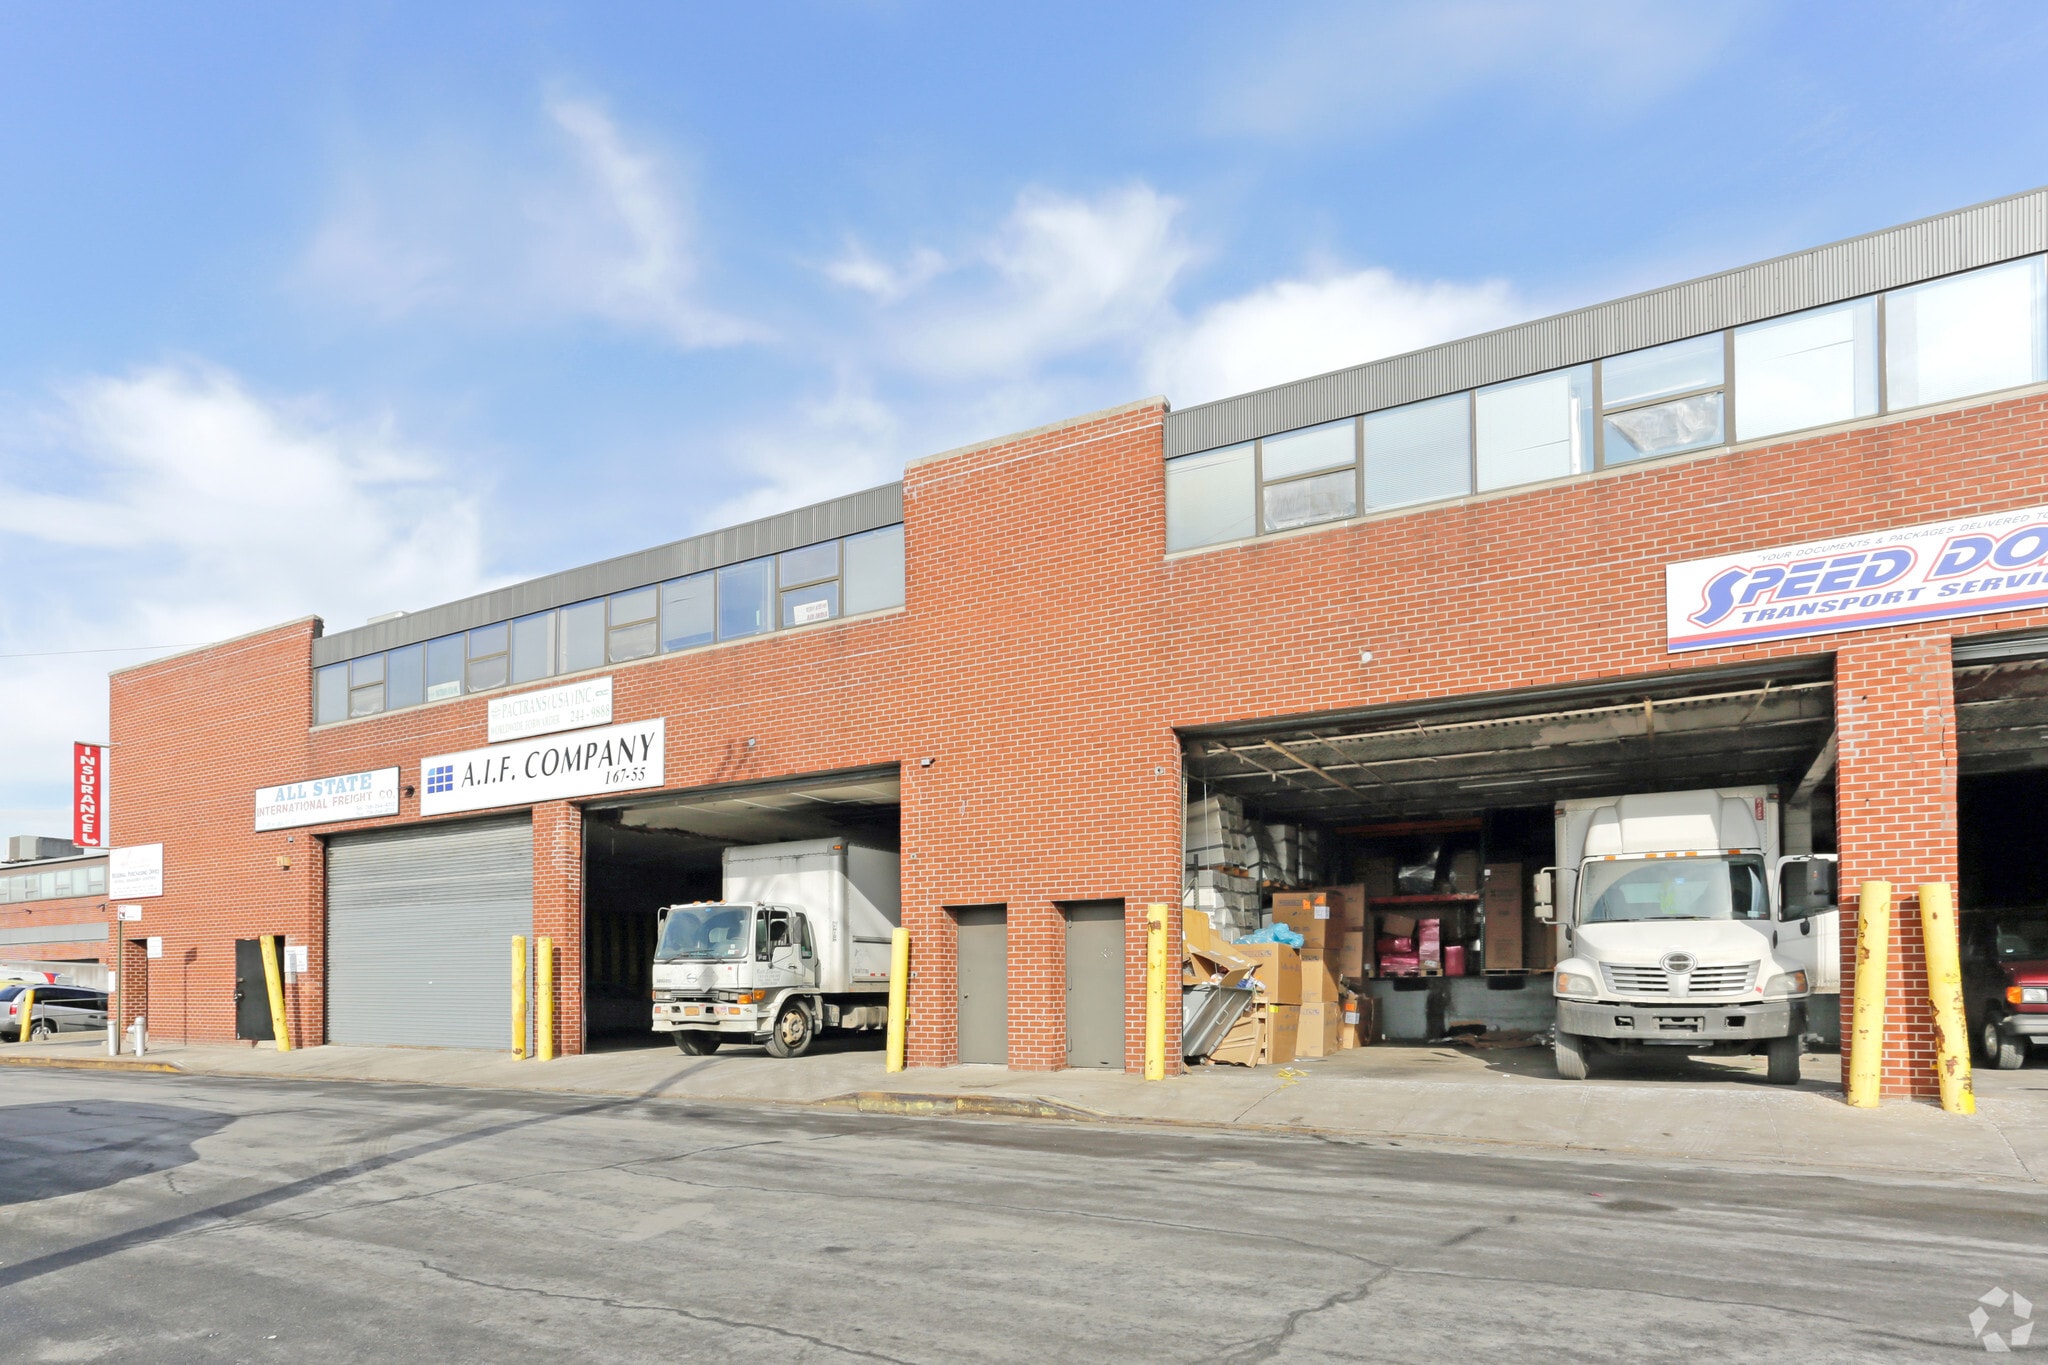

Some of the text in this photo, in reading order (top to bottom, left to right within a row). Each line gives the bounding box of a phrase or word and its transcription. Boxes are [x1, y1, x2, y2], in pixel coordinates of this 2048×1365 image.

[1796, 538, 1871, 557] DOCUMENTS
[1889, 526, 1956, 542] PACKAGES
[1959, 514, 2030, 531] DELIVERED
[1692, 549, 1913, 626] SPEED
[1741, 571, 2048, 624] TRANSPORT SERVI
[461, 731, 656, 788] A.I.F. COMPANY
[604, 766, 647, 785] 167-55
[80, 746, 96, 833] INSURANCE
[256, 798, 328, 817] INTERNATIONAL
[332, 791, 373, 807] FREIGHT
[275, 773, 373, 802] ALL STATE
